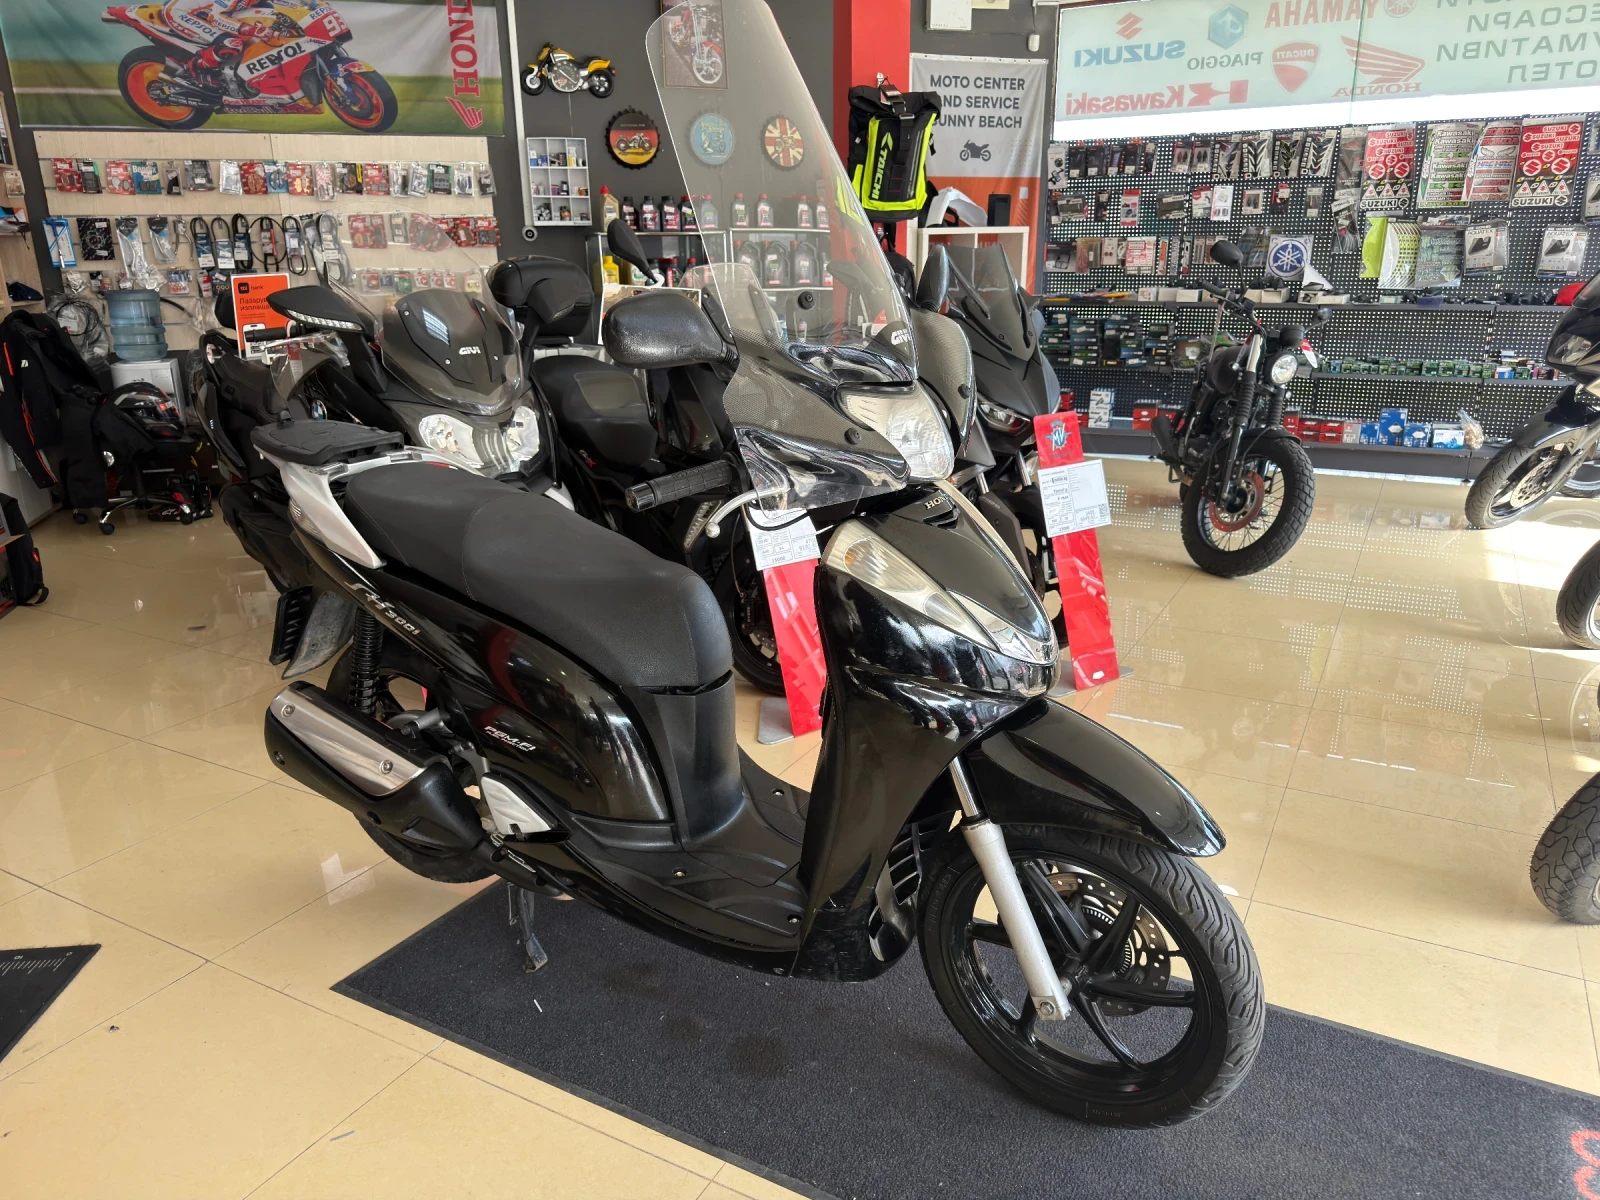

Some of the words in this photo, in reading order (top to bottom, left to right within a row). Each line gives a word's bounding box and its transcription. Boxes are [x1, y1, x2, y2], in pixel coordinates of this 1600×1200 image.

[178, 14, 217, 38] REPSOL
[322, 14, 349, 37] 93
[245, 41, 306, 75] REPSOL
[930, 74, 970, 88] MOTO
[973, 77, 1026, 91] CENTER
[965, 96, 1020, 110] SERVICE
[978, 116, 1023, 129] BEACH
[872, 149, 888, 200] TAICHI
[1361, 200, 1397, 208] SUZUKI
[1512, 198, 1553, 206] SUZUKI
[459, 346, 481, 355] GIVI
